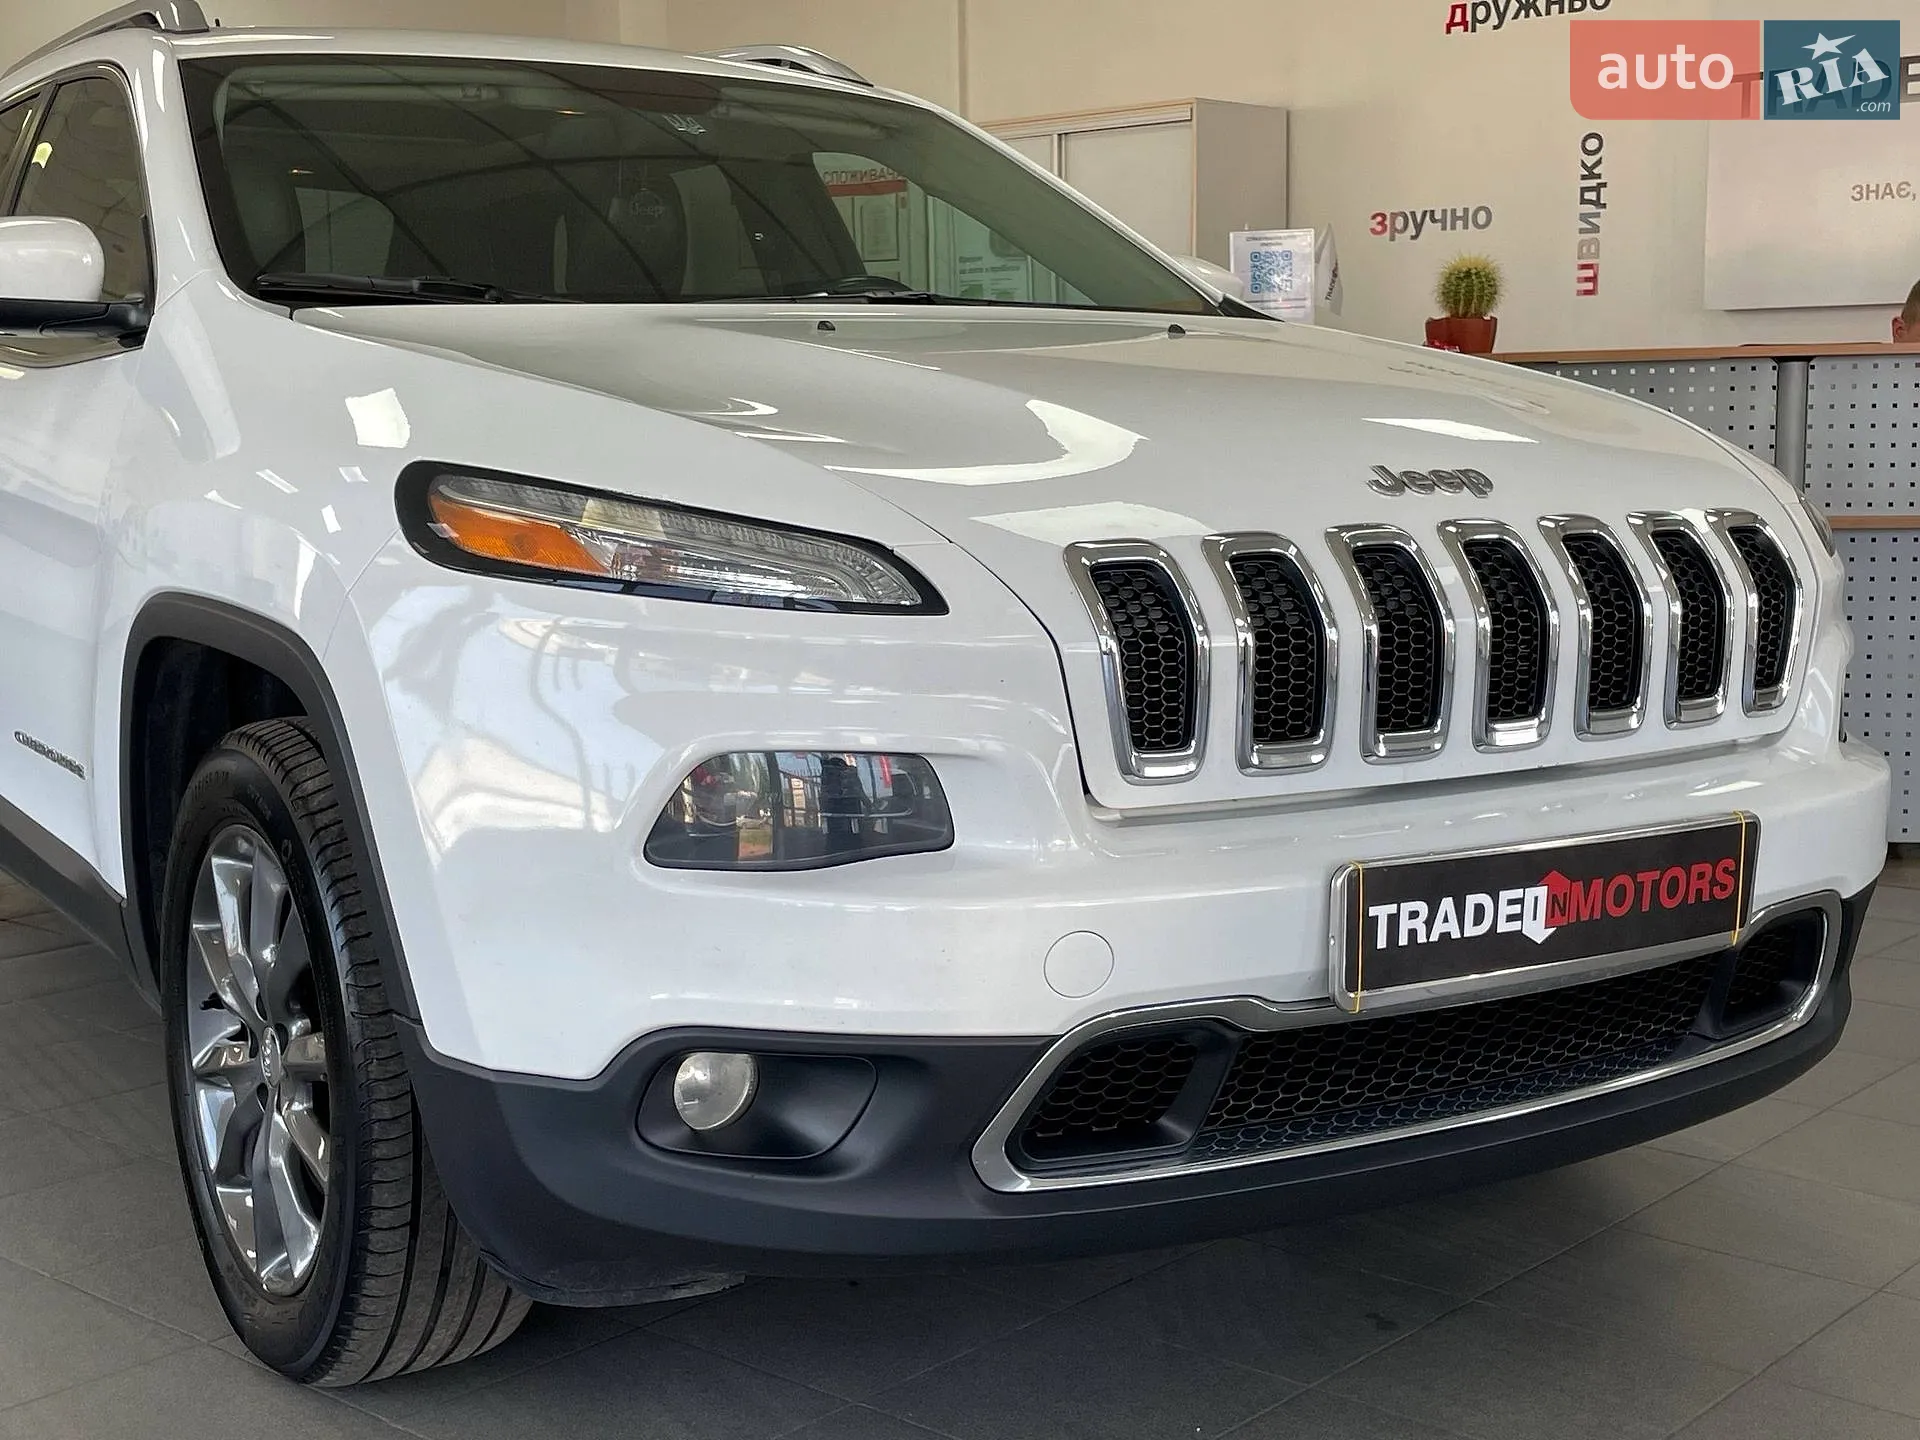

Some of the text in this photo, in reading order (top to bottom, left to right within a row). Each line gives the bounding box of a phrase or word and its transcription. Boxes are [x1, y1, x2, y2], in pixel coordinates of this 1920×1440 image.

[823, 167, 899, 185] СПОЖИВАЧ
[1850, 180, 1917, 202] ЗНАЄ,
[1369, 205, 1494, 242] зручно
[1576, 132, 1607, 296] швидко
[1366, 465, 1494, 498] Jeep
